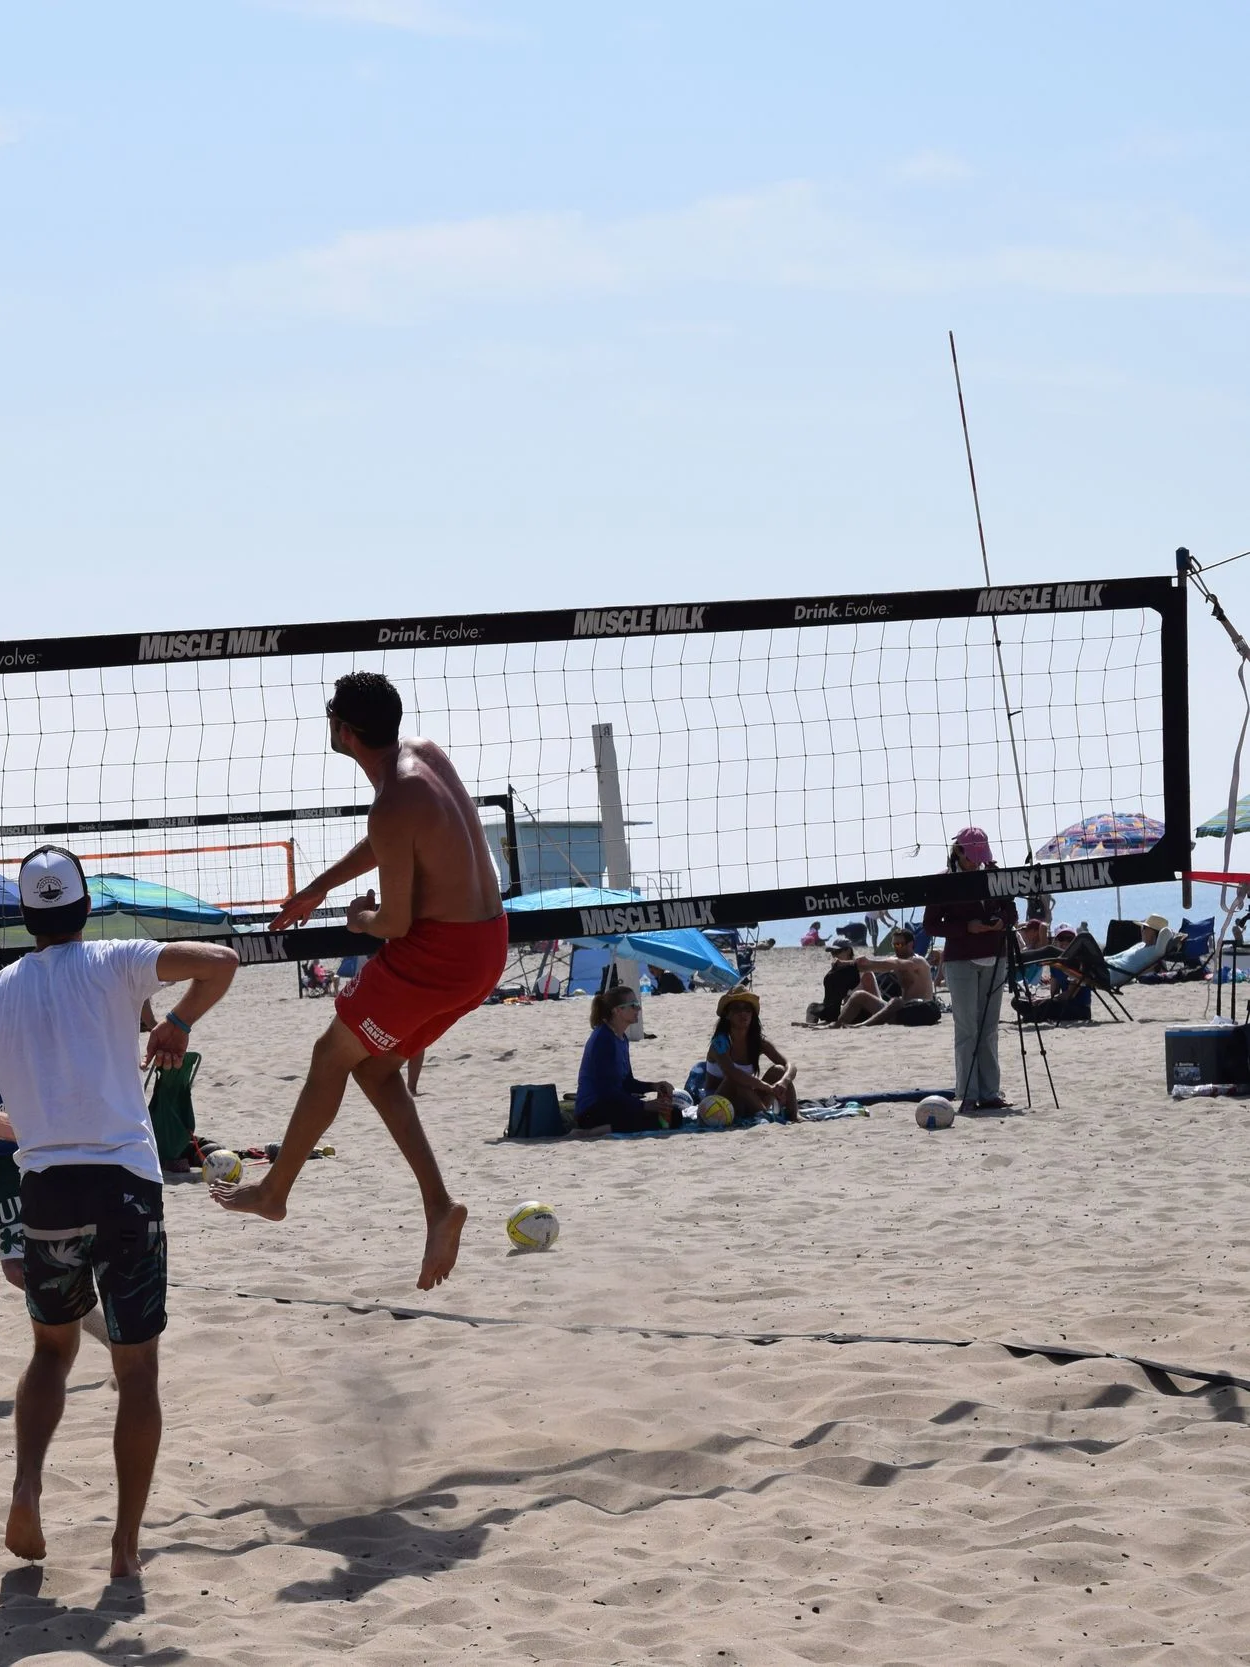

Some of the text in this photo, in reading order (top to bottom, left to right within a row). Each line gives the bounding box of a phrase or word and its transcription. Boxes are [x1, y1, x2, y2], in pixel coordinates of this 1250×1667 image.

[795, 600, 890, 620] Drink. Evolve.
[976, 583, 1103, 612] MUSCLE MILK
[378, 622, 482, 643] Drink. Evolve.
[573, 606, 705, 635] MUSCLE MILK
[138, 629, 281, 661] MUSCLE MILK
[148, 816, 195, 828] MUSCLE MILK
[295, 808, 342, 819] MUSCLE MILK
[27, 825, 45, 835] MILK
[1065, 862, 1114, 889] MILK
[805, 886, 901, 911] Drink. Evolve.
[580, 900, 715, 936] MUSCLE MILK
[231, 935, 289, 963] MILK
[361, 1020, 390, 1047] SANTA
